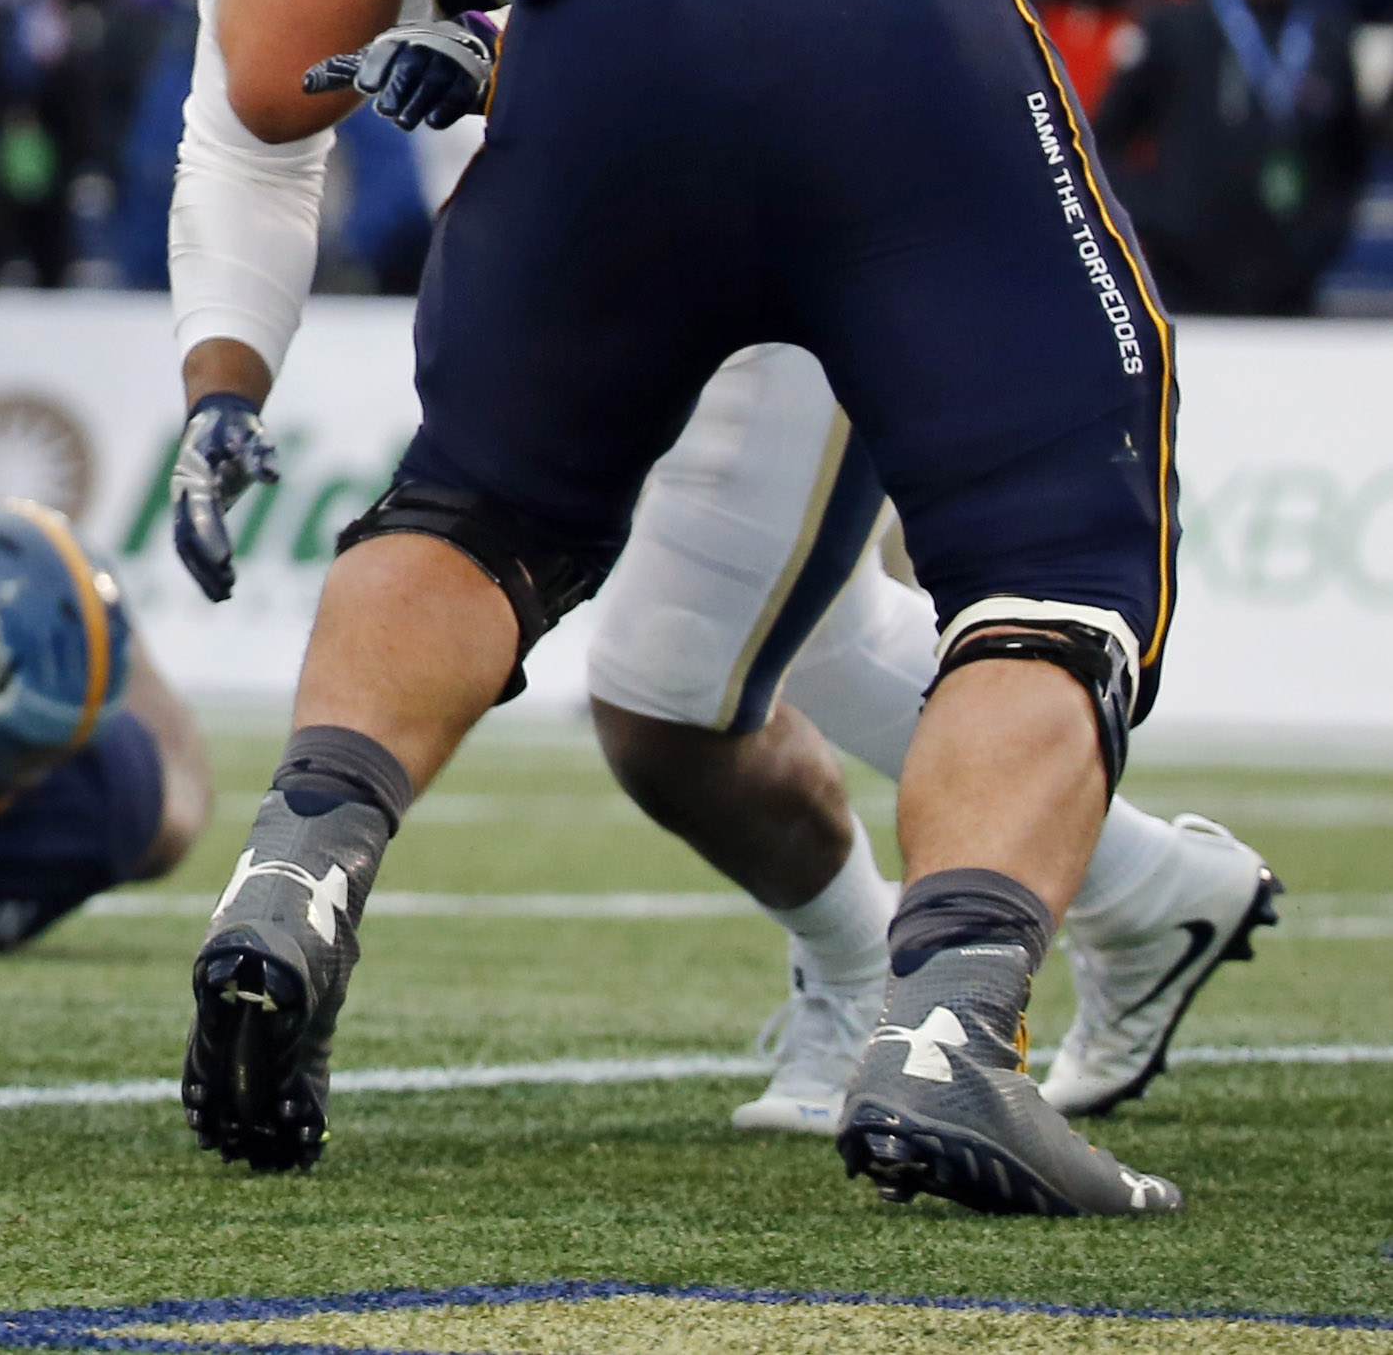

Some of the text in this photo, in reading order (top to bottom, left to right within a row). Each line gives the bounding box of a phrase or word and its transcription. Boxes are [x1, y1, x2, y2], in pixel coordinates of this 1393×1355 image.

[1026, 90, 1145, 376] DAMN THE TORPEDOES
